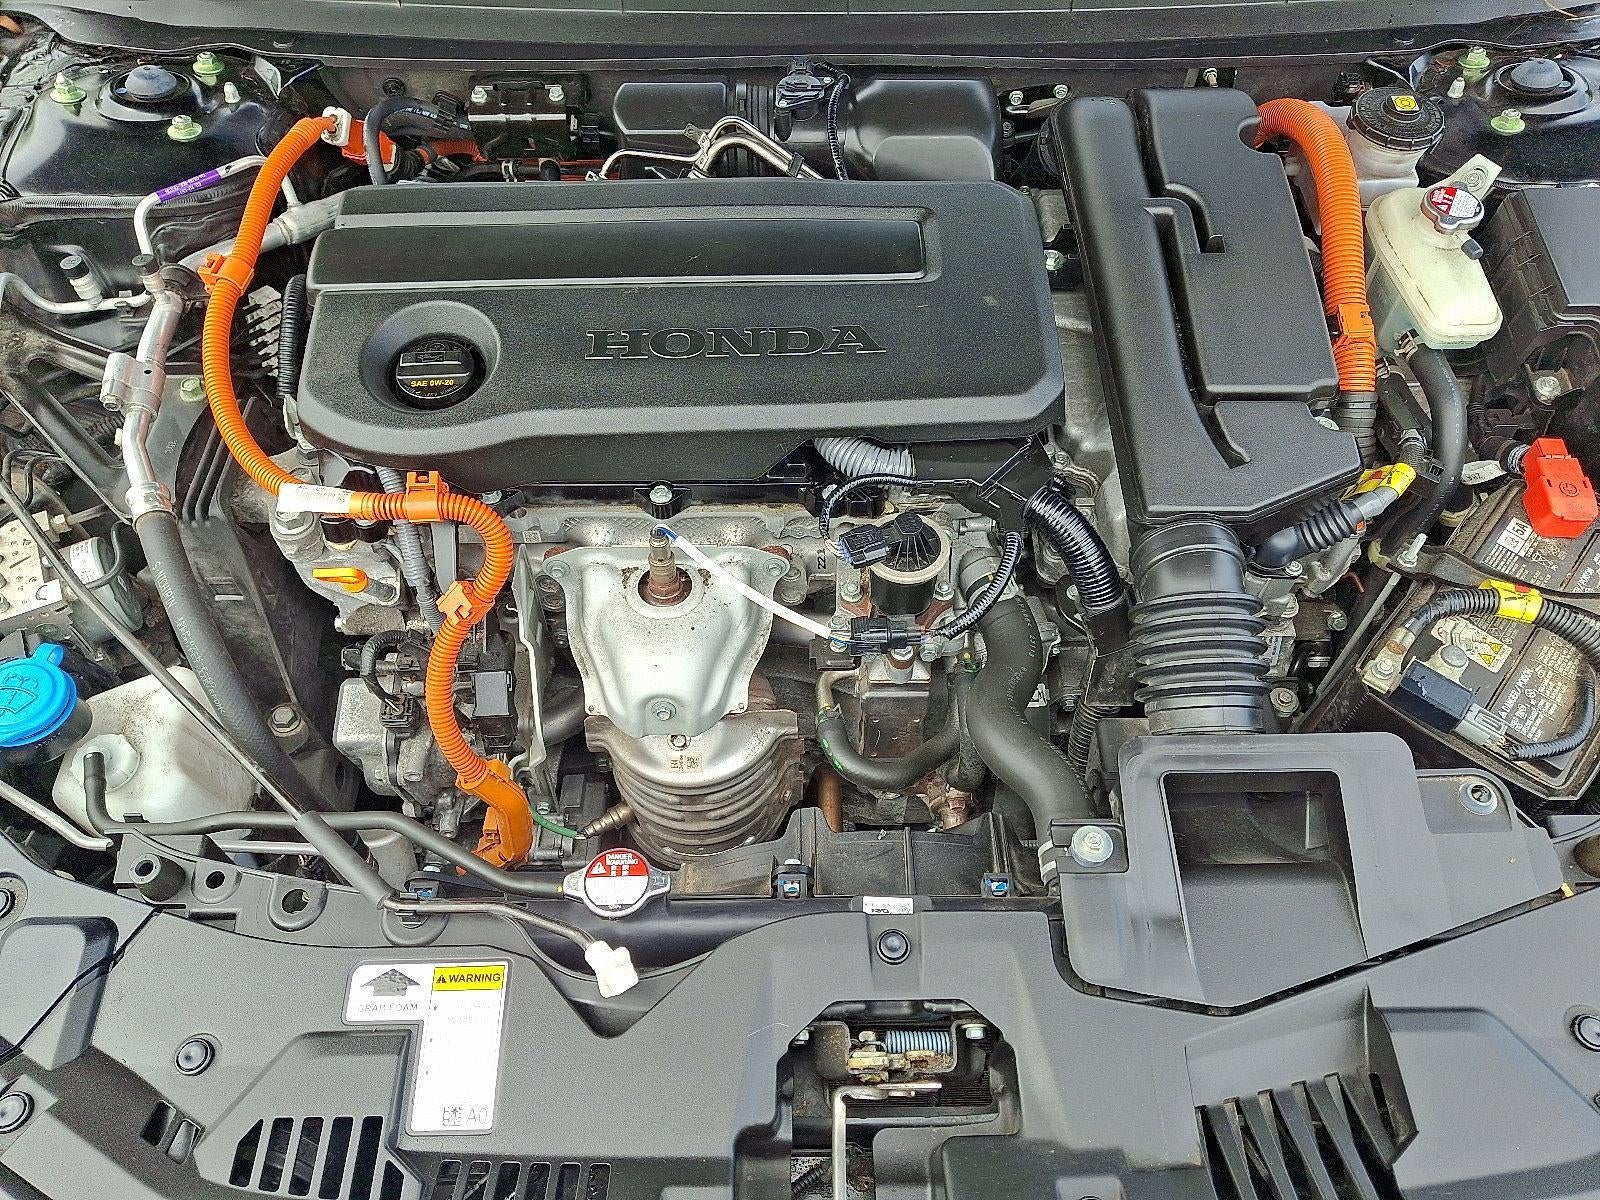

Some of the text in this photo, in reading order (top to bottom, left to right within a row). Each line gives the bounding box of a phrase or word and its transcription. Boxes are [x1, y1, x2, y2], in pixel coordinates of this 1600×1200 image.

[584, 325, 887, 359] HONDA
[410, 379, 454, 388] SAE 0W-20
[448, 972, 501, 983] WARNING
